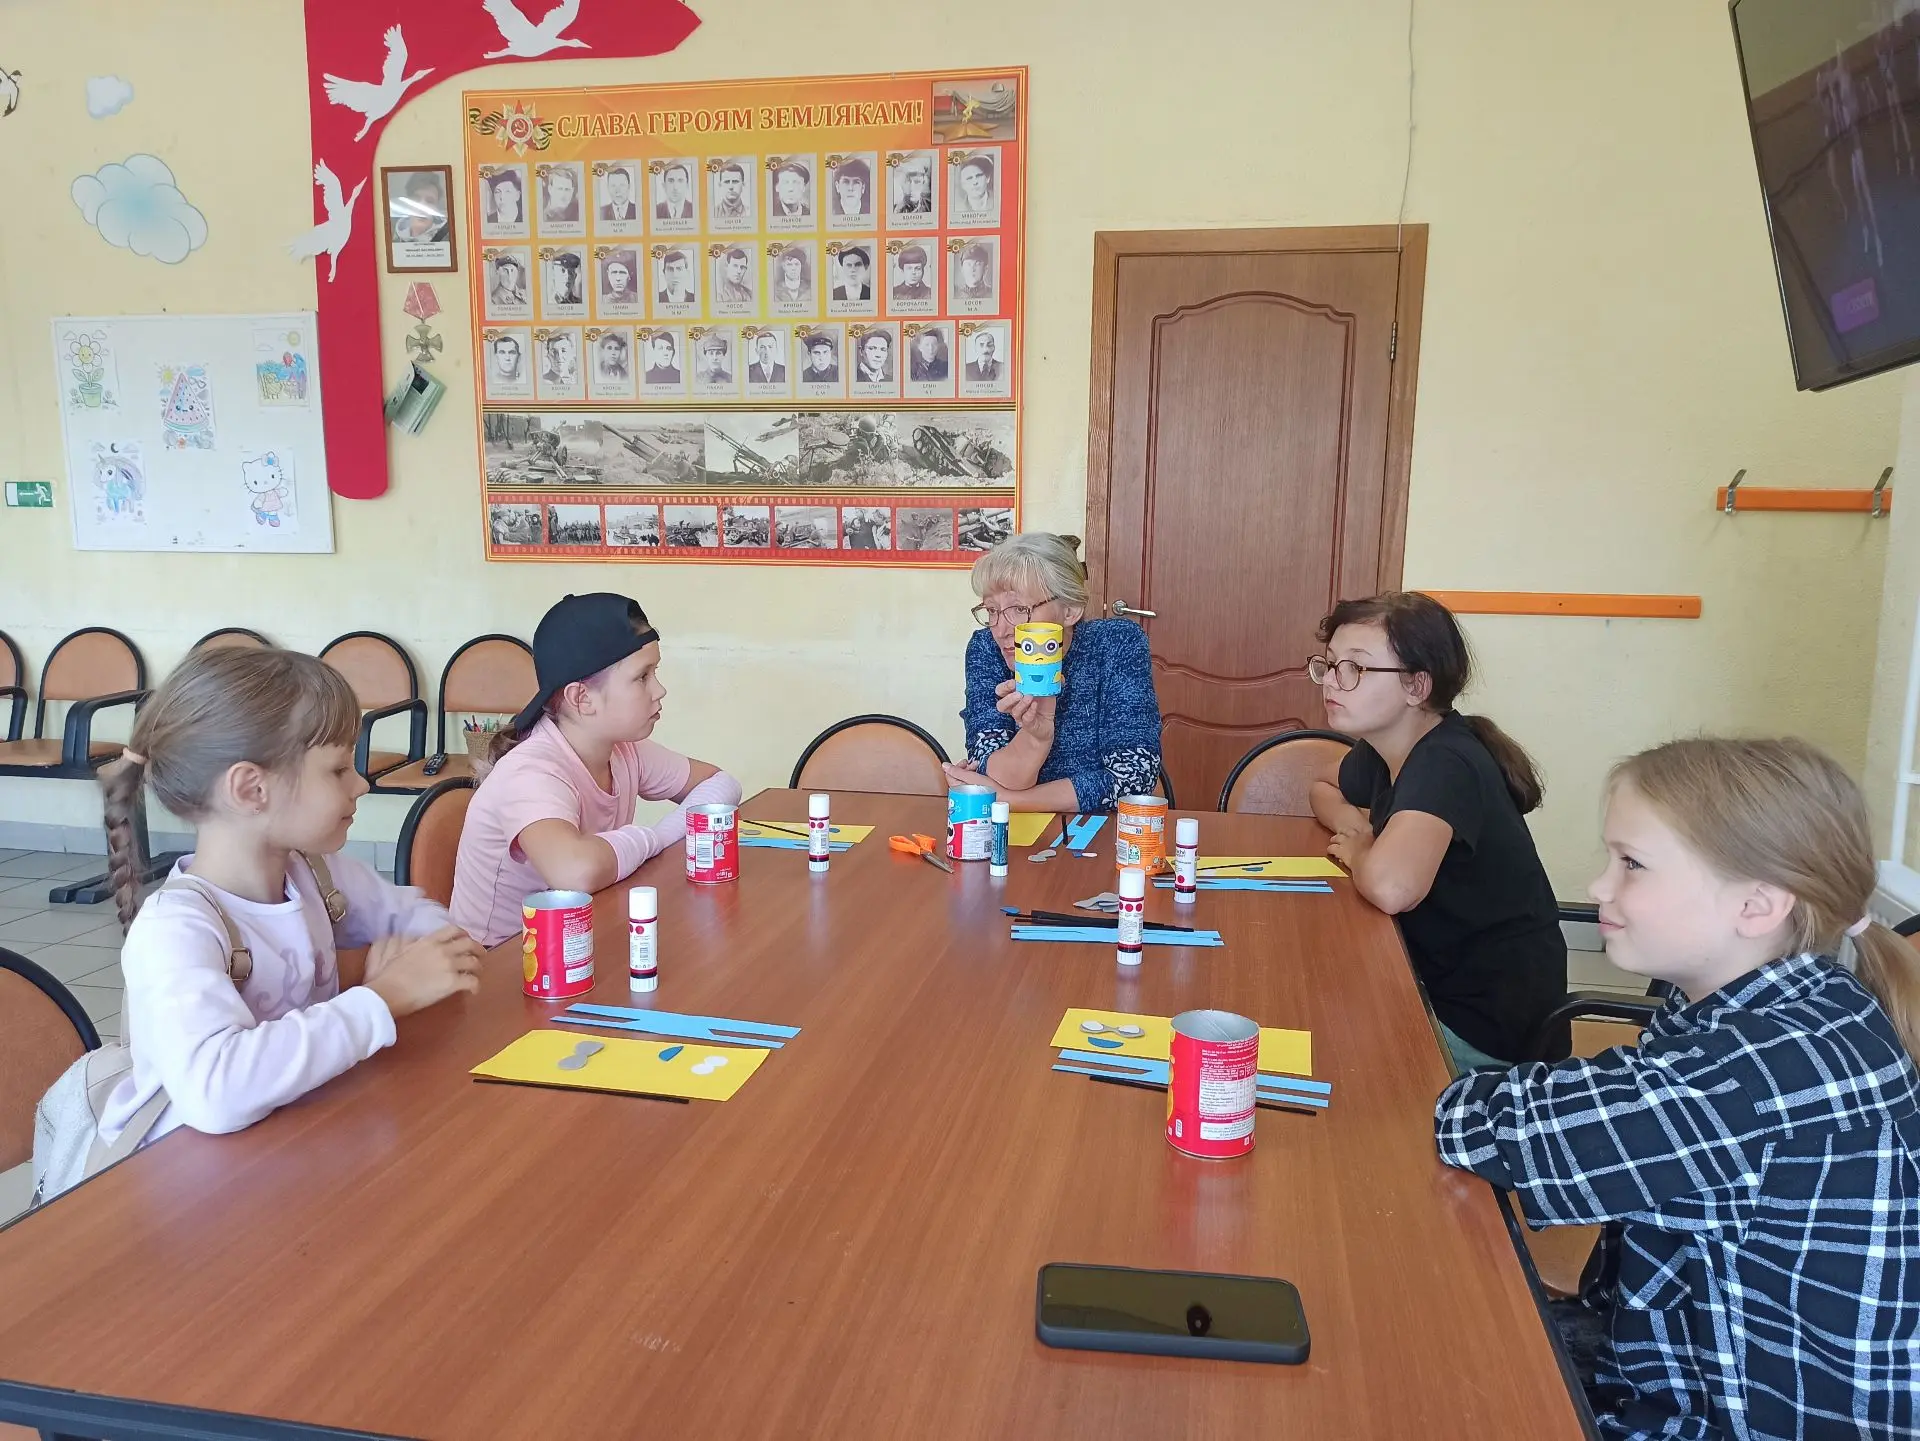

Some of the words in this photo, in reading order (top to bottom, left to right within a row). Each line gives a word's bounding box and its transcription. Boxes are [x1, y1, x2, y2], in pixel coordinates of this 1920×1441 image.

[556, 113, 643, 138] СЛАВА
[648, 107, 753, 134] ГЕРОЯМ
[760, 101, 923, 129] ЗЕМЛЯКАМ!
